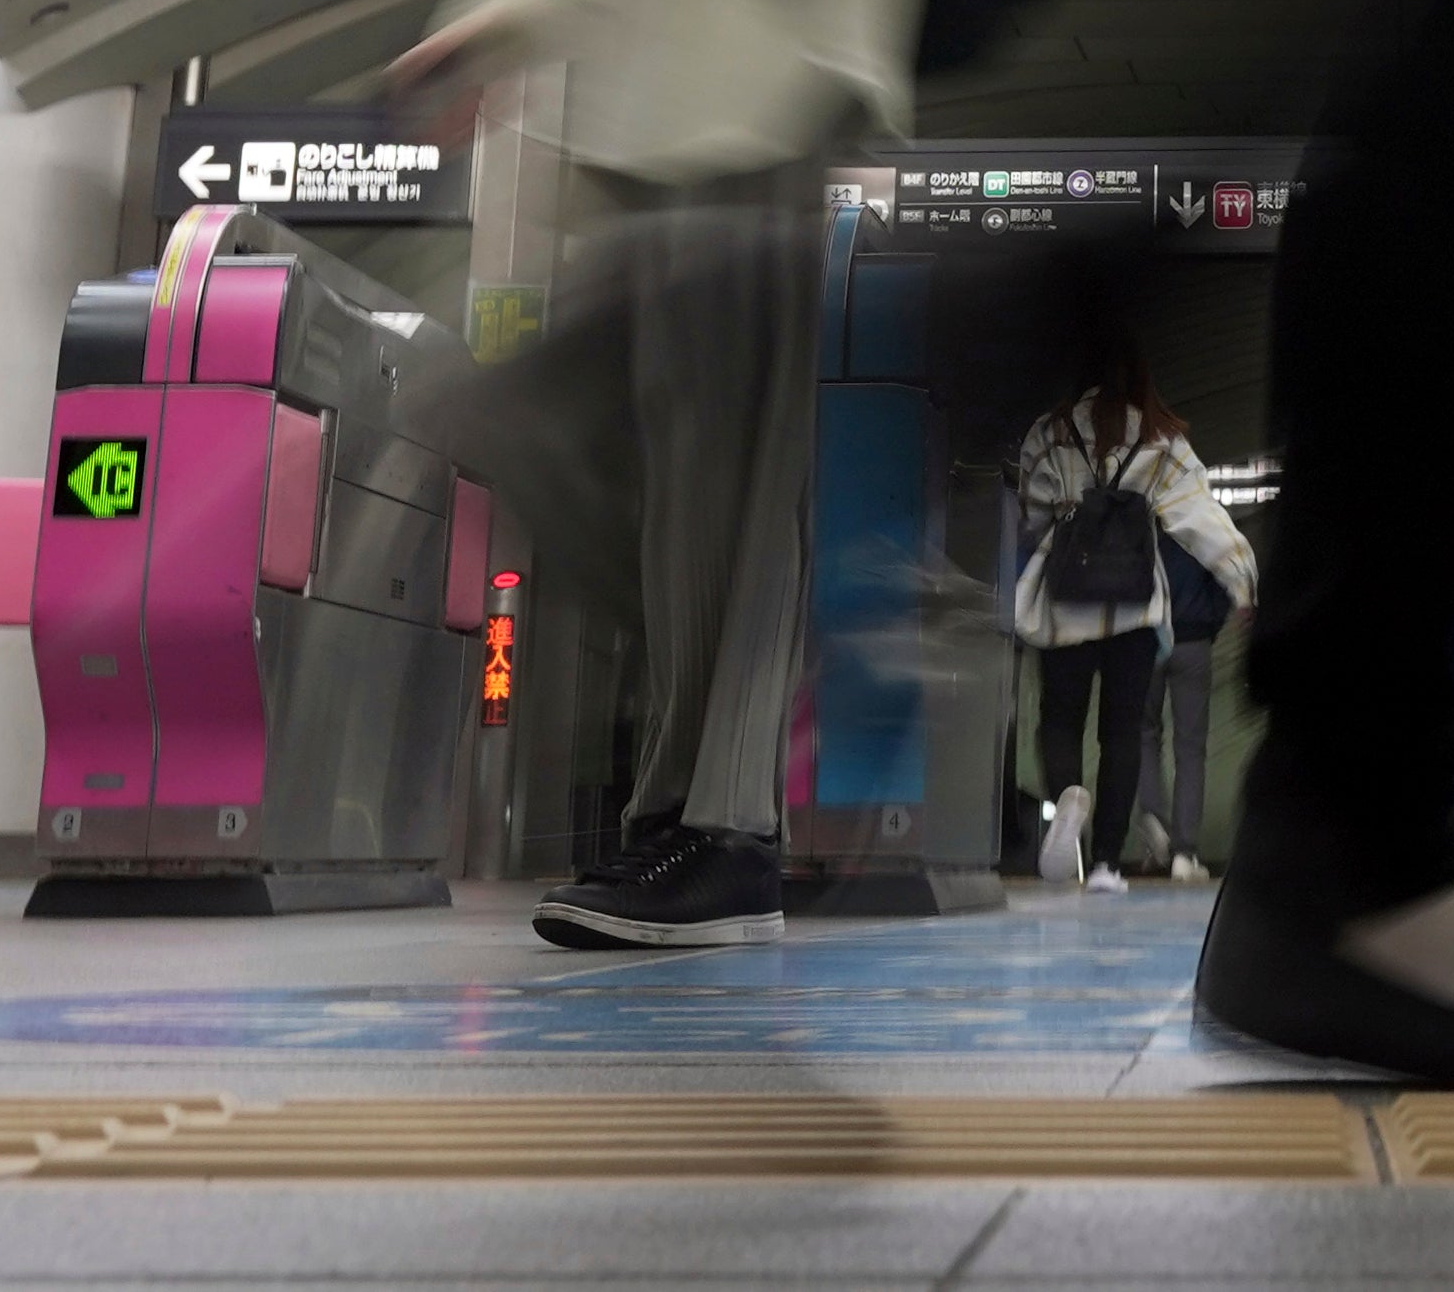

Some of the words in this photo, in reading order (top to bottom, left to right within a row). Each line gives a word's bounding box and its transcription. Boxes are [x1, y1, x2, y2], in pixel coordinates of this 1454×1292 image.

[929, 172, 979, 187] のりかえ階
[987, 178, 1006, 191] DT
[1010, 171, 1063, 186] 田園都市線
[929, 209, 971, 223] ホーム階
[1220, 194, 1246, 217] TY
[482, 615, 514, 725] 進入禁止
